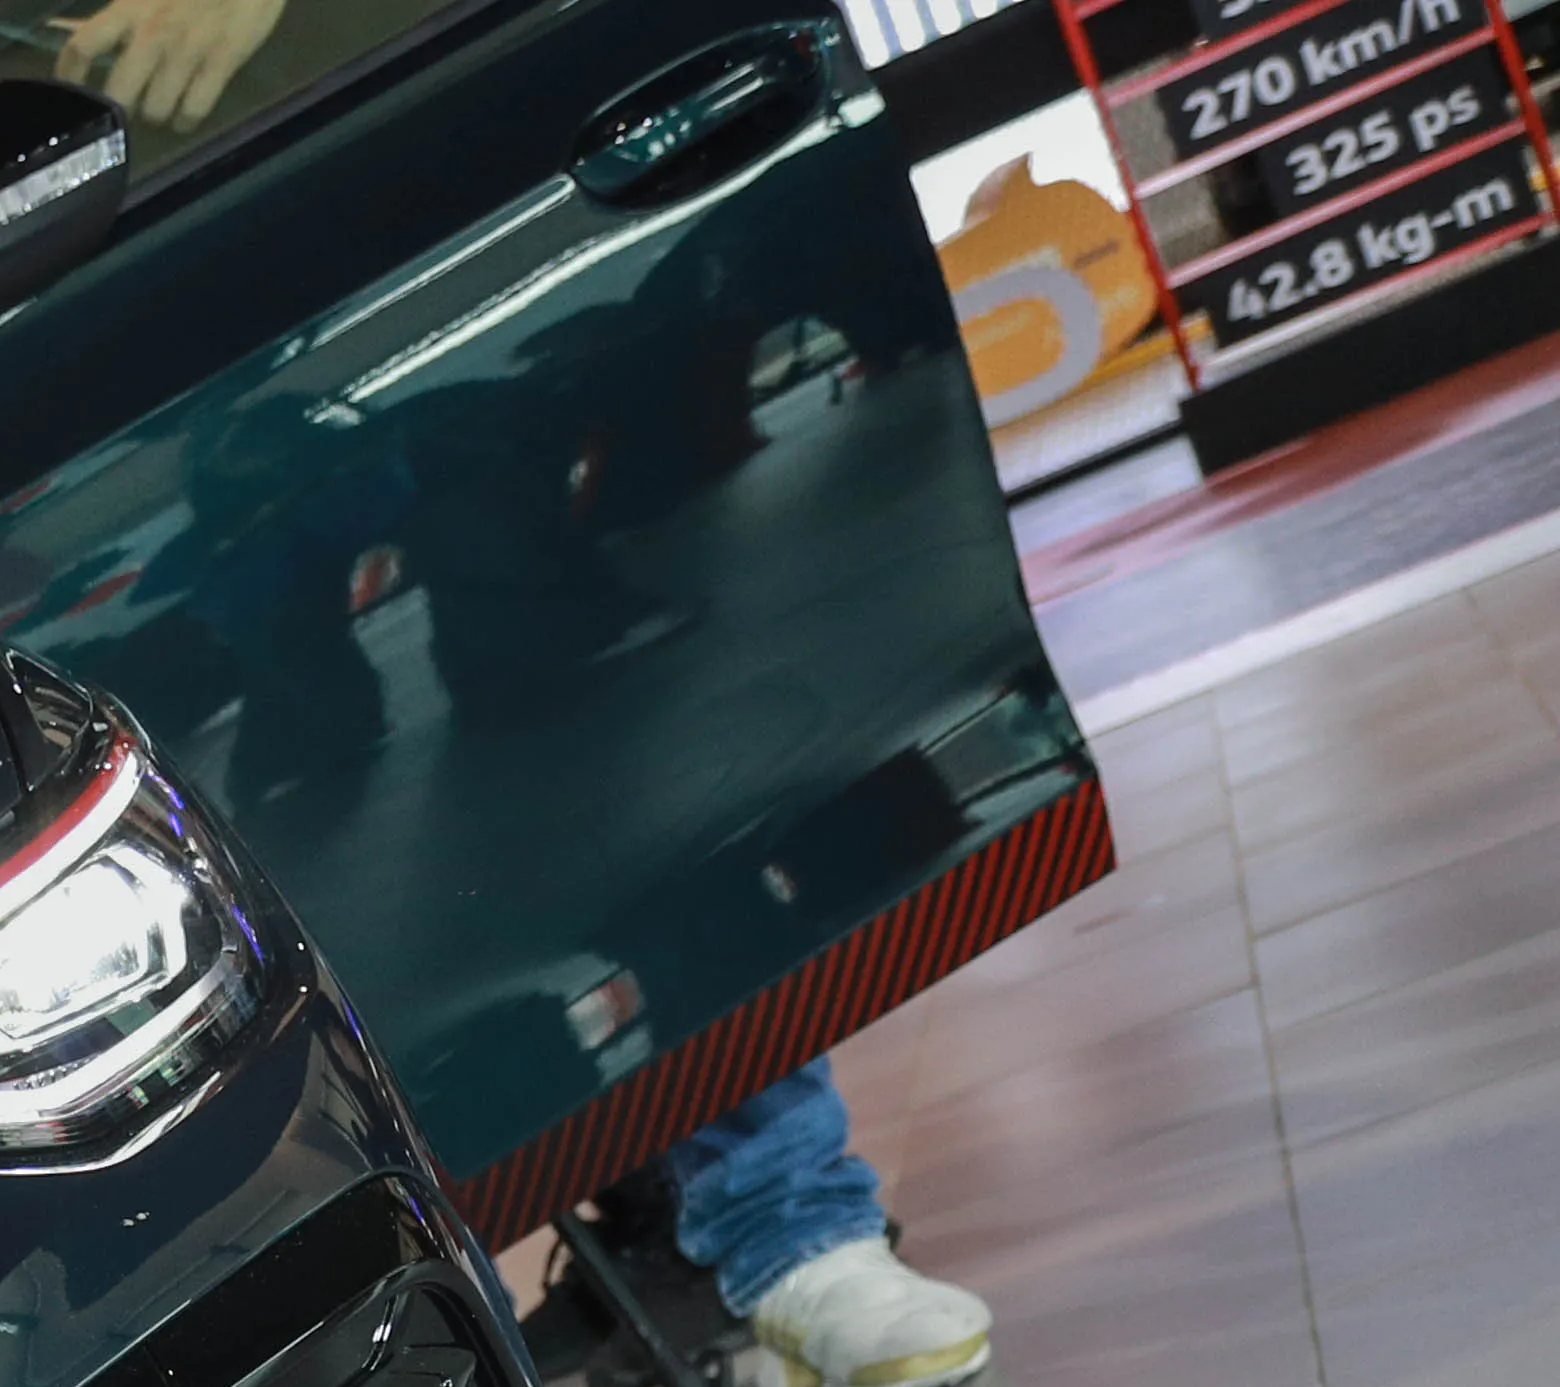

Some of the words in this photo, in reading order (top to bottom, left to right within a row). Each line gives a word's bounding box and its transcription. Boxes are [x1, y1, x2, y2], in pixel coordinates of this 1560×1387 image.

[1181, 54, 1296, 141] 270
[1299, 0, 1462, 86] km/h
[1285, 109, 1402, 196] 325
[1408, 85, 1481, 152] ps
[1226, 238, 1355, 322] 42.8
[1356, 178, 1515, 268] kg-m
